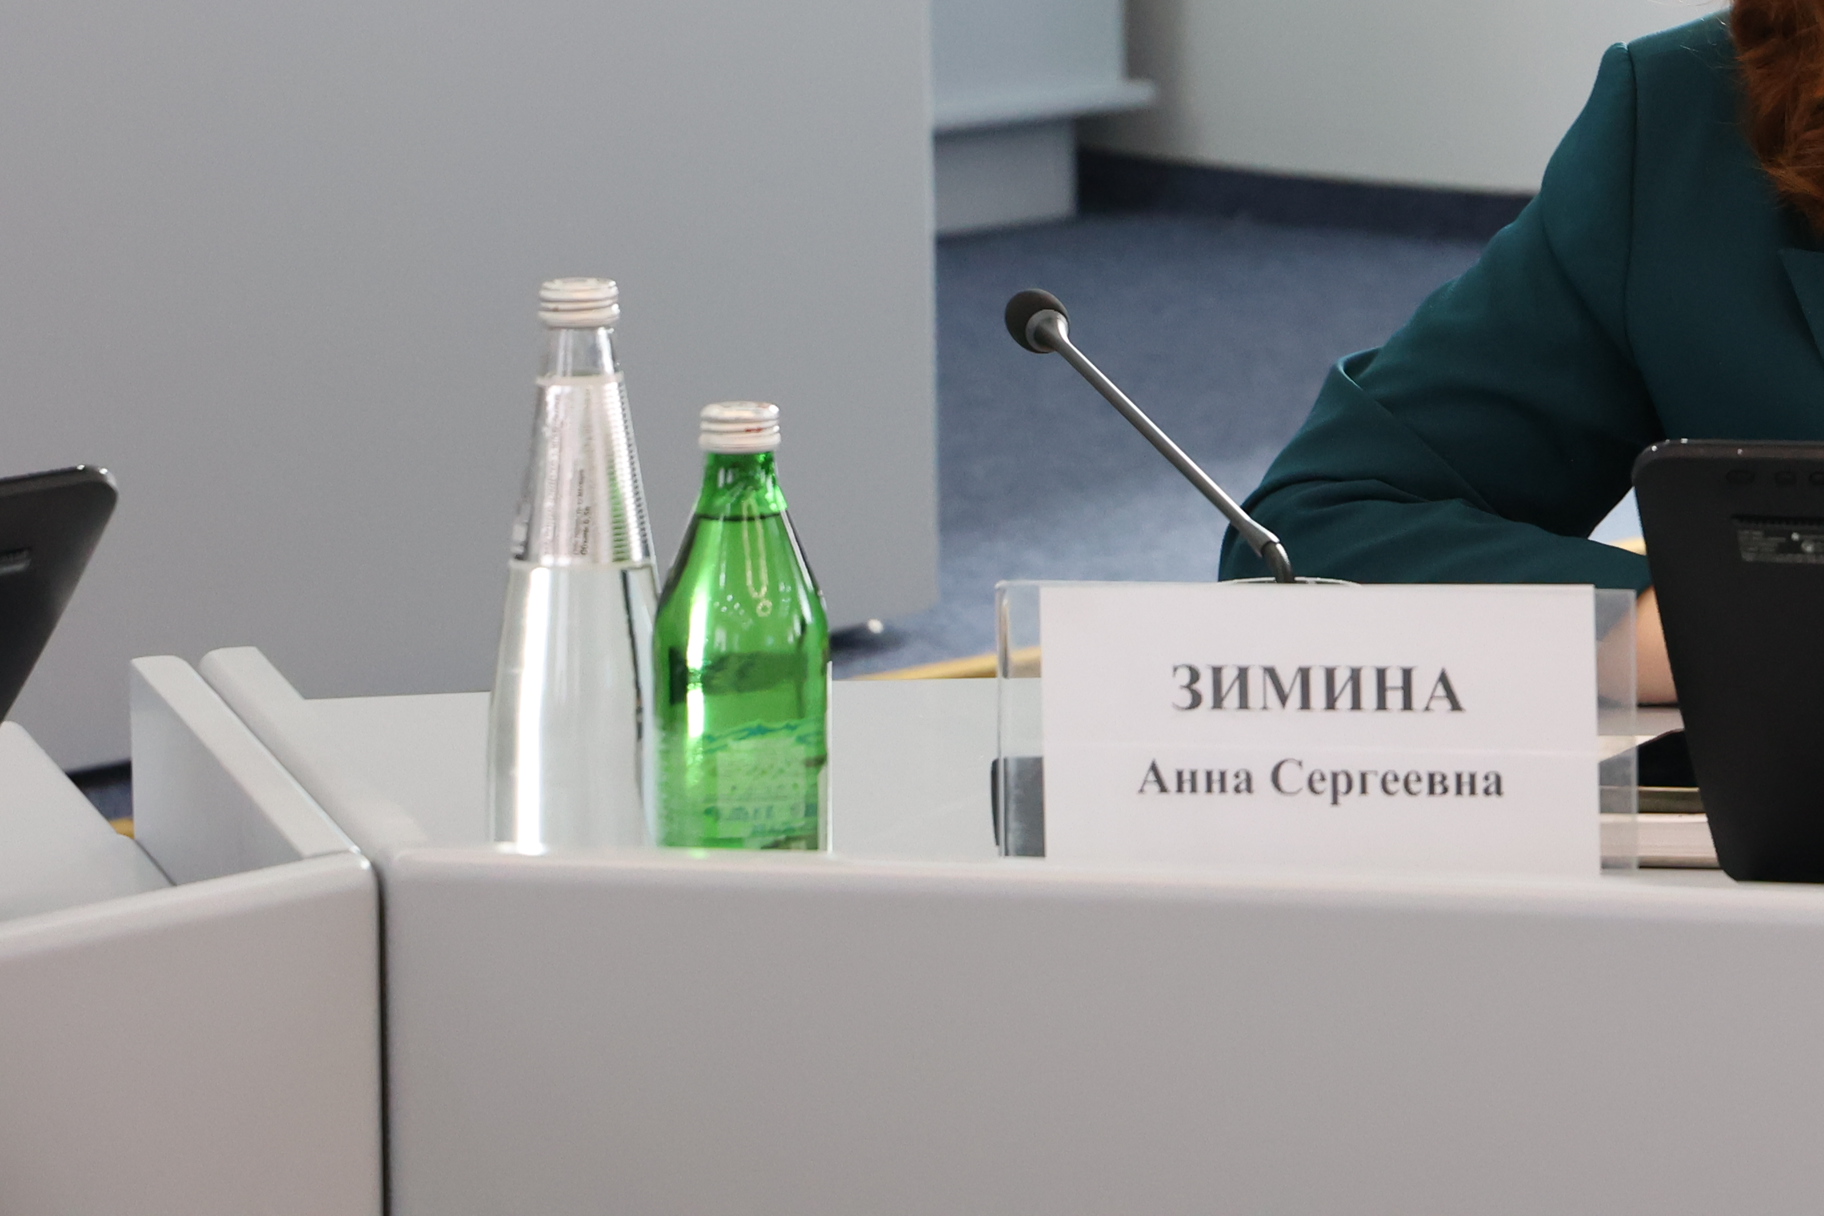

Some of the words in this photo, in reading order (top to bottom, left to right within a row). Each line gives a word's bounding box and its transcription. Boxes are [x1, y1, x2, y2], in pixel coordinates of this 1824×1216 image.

[1171, 663, 1466, 713] ЗИМИНА
[1137, 758, 1255, 796] Анна
[1270, 758, 1504, 808] Сергеевна
